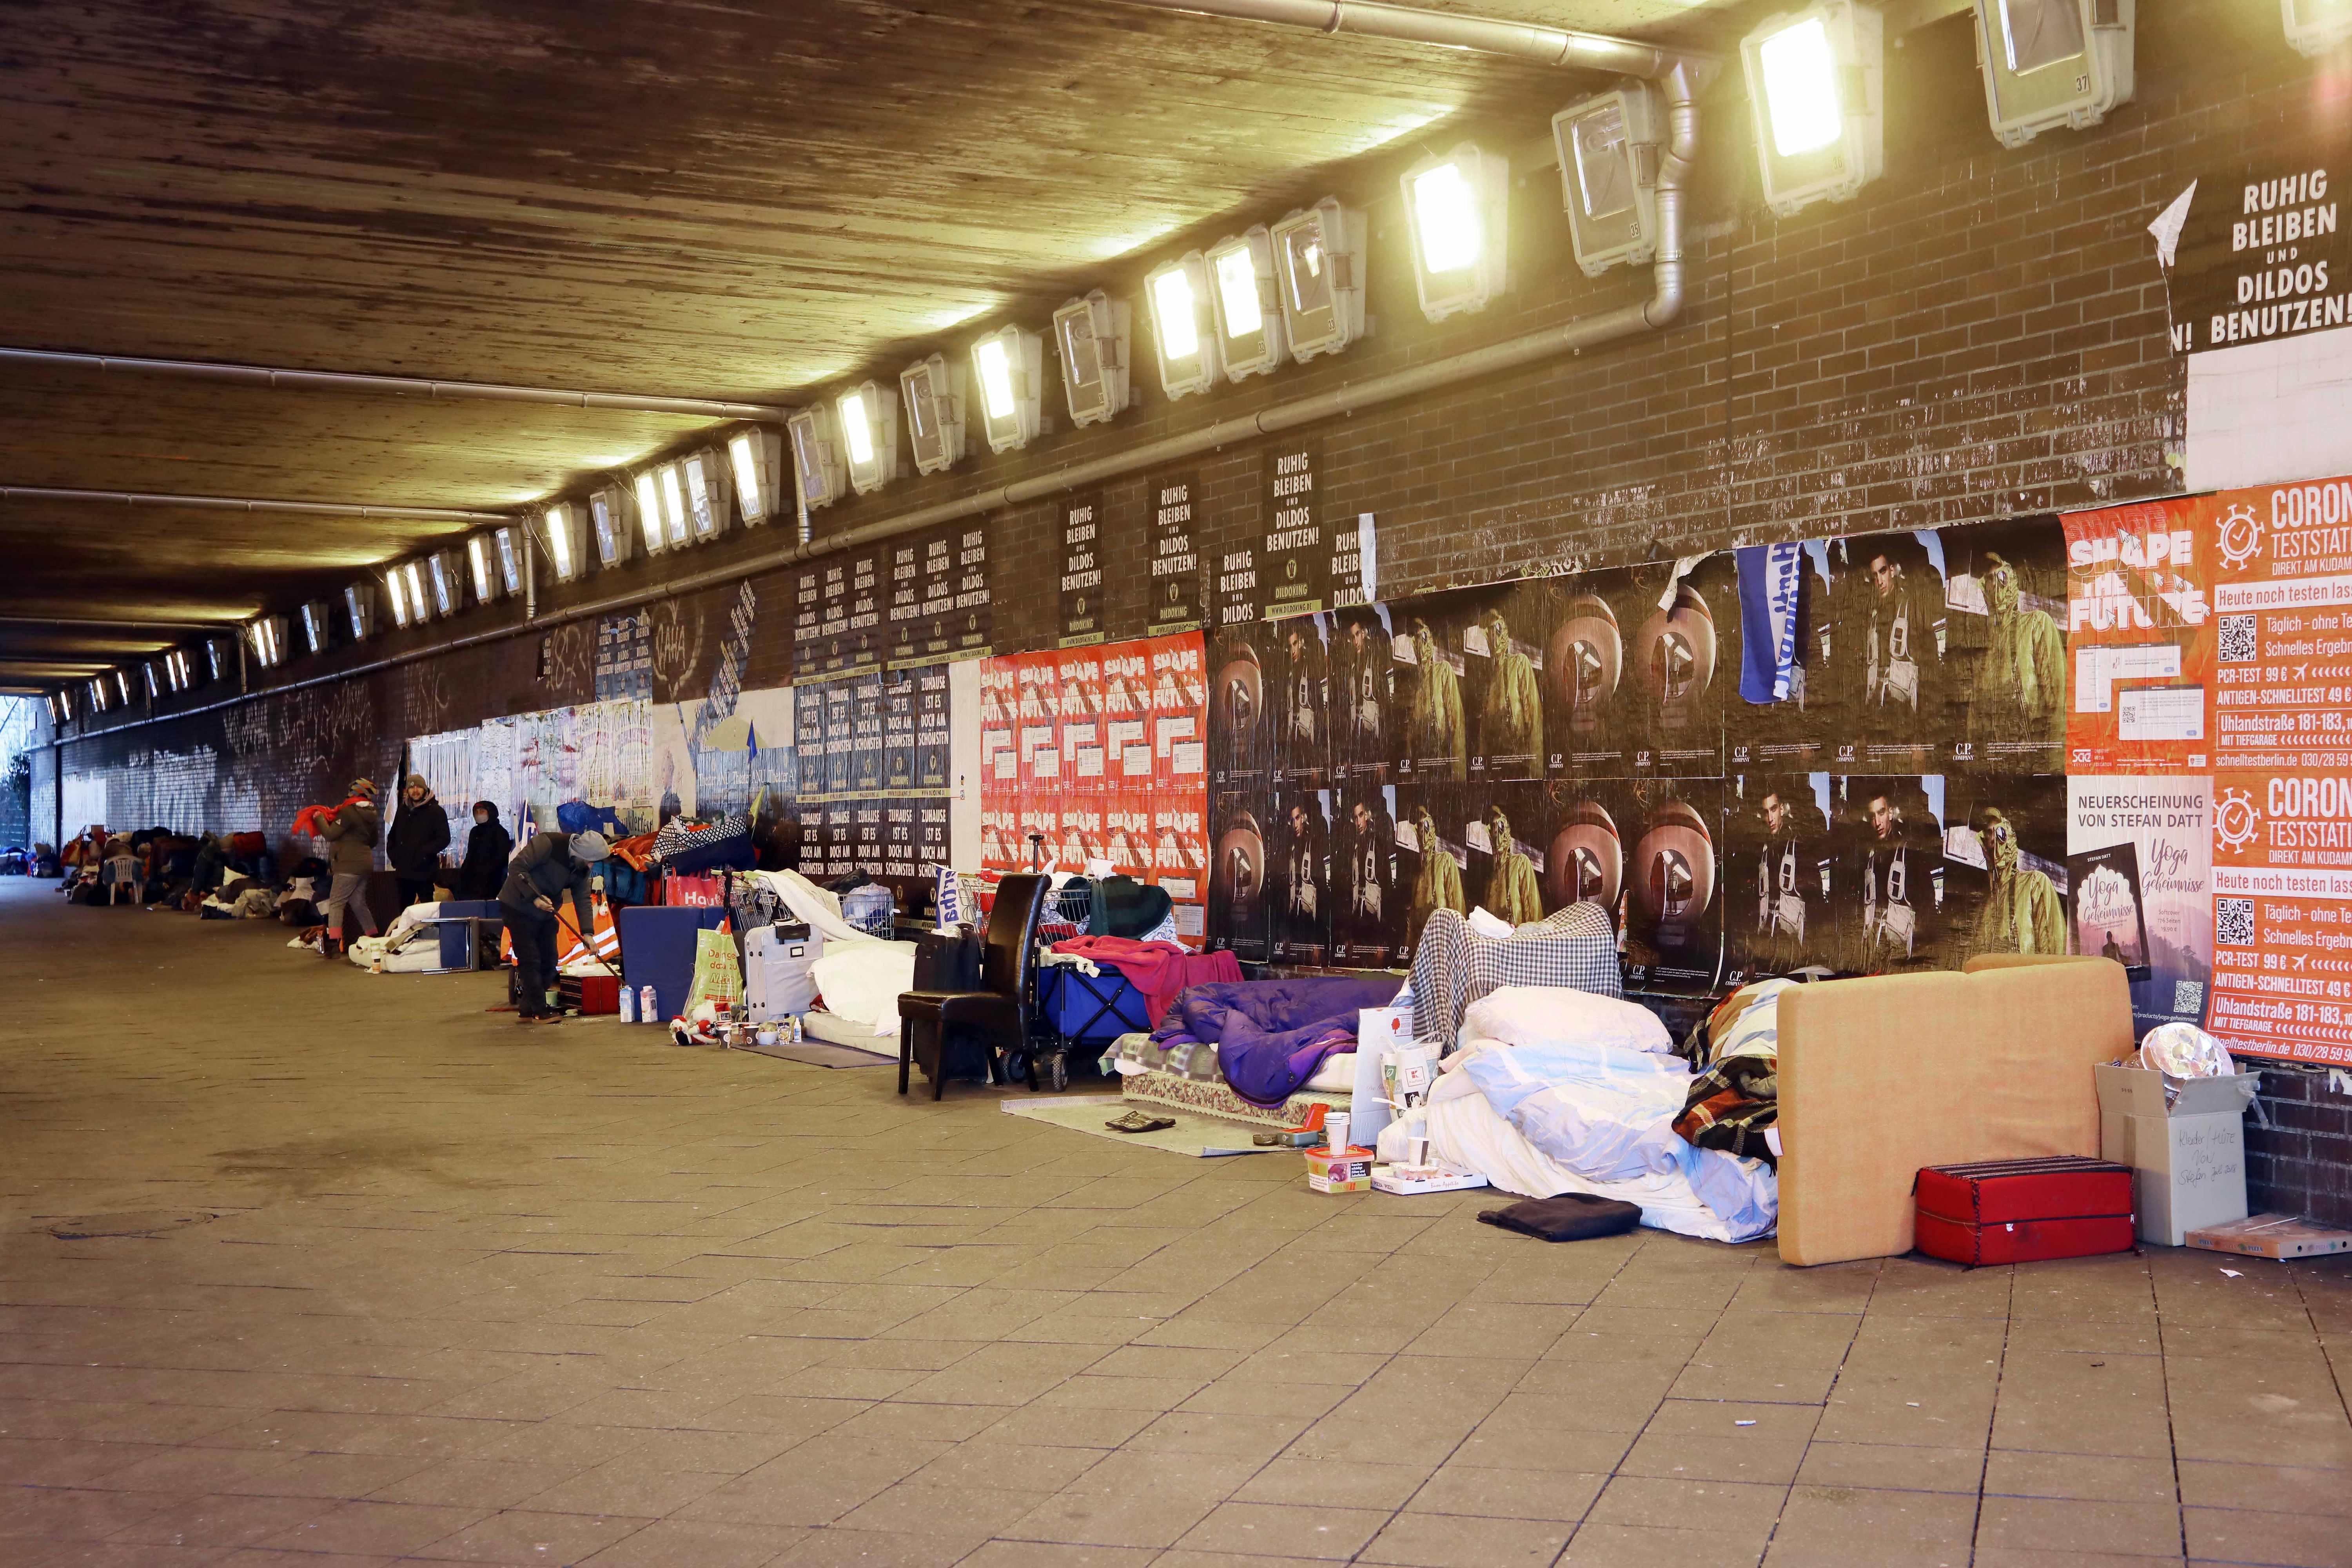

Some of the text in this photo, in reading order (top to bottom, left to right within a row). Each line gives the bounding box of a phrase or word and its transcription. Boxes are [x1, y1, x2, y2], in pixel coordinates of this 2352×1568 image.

[2244, 169, 2327, 214] RUHIG
[2233, 203, 2337, 252] BLEIBEN
[2267, 247, 2298, 264] UND
[2238, 261, 2328, 303] DILDOS
[2211, 293, 2352, 344] BENUTZEN!
[1278, 452, 1308, 475] RUHIG
[1274, 473, 1312, 497] BLEIBEN
[1161, 485, 1187, 505] RUHIG
[1287, 497, 1298, 506] UND
[1158, 504, 1191, 526] BLEIBEN
[2272, 483, 2352, 529] CORON
[1070, 506, 1092, 526] RUHIG
[1276, 506, 1309, 529] DILDOS
[963, 530, 982, 548] RUHIG
[1067, 524, 1095, 544] BLEIBEN
[1267, 527, 1319, 552] BENUTZEN!
[1076, 544, 1085, 552] UND
[1160, 535, 1188, 555] DILDOS
[2070, 530, 2192, 575] SHAPE
[961, 547, 985, 566] BLEIBEN
[1069, 552, 1093, 572] DILDOS
[1152, 554, 1196, 576] BENUTZEN!
[2272, 561, 2302, 575] DIREKT
[2304, 559, 2317, 573] AM
[800, 574, 815, 589] RUHIG
[962, 573, 983, 591] DILDOS
[1062, 570, 1101, 592] BENUTZEN!
[1345, 575, 1357, 584] UND
[2082, 573, 2128, 599] THE
[799, 589, 817, 604] BLEIBEN
[956, 590, 989, 609] BENUTZEN!
[1275, 584, 1308, 599] DILDOKING
[1334, 587, 1363, 606] DILDO
[2220, 582, 2352, 606] Heute noch testen las
[799, 611, 815, 626] DILDOS
[1160, 606, 1187, 619] DILDOKING
[1271, 603, 1312, 615] WWW.DILDOKING.DE
[2070, 590, 2204, 633] FUTURE
[795, 625, 820, 641] BENUTZEN!
[2266, 616, 2301, 635] Täglich
[2312, 614, 2338, 630] ohne
[2266, 640, 2314, 657] Schnelles
[1153, 650, 1197, 675] SHAPE
[922, 675, 945, 691] ZUHAUSE
[2218, 667, 2287, 684] PCR-TEST 99 €
[935, 695, 941, 708] ES
[1153, 685, 1205, 709] FUTURE
[2217, 687, 2351, 705] ANTIGEN-SCHNELLTEST 49 €
[921, 712, 946, 728] DOCH AM
[2221, 713, 2346, 733] Uhlandstraße 181-183,
[918, 728, 949, 745] SCHÖNSTEN
[2221, 734, 2278, 746] MIT TIEFGARAGE
[1839, 746, 1853, 757] C.P.
[1956, 743, 1972, 755] C.P.
[2216, 753, 2348, 770] schnelltestberlin.de 030/28 59
[2079, 795, 2203, 809] NEUERSCHEINUNG
[2268, 778, 2352, 817] CORON
[888, 809, 912, 822] ZUHAUSE
[1156, 812, 1199, 834] SHAPE
[2078, 814, 2203, 828] VON STEFAN DATT
[1156, 848, 1206, 869] FUTURE
[2151, 838, 2188, 876] Yoga
[2269, 850, 2299, 863] DIREKT
[2301, 851, 2315, 864] AM
[886, 860, 915, 877] SCHÖNSTEN
[2142, 871, 2204, 897] Geheimnisse
[2216, 871, 2249, 889] Heute
[2254, 874, 2282, 890] noch
[2287, 874, 2326, 892] testen
[2089, 876, 2118, 909] Yoga
[2084, 904, 2134, 927] Geheimnisse
[2264, 904, 2300, 923] Täglich
[2311, 907, 2337, 923] ohne
[2264, 928, 2313, 946] Schnelles
[1633, 965, 1645, 975] C.P.
[2216, 951, 2287, 970] PCR-TEST 99 €
[2214, 972, 2350, 998] ANTIGEN-SCHNELLTEST 49 €
[2216, 997, 2343, 1028] Uhlandstraße 181-183,
[2214, 1016, 2272, 1033] MIT TIEFGARAGE
[2294, 1043, 2328, 1059] 030/28
[2329, 1047, 2343, 1061] 59
